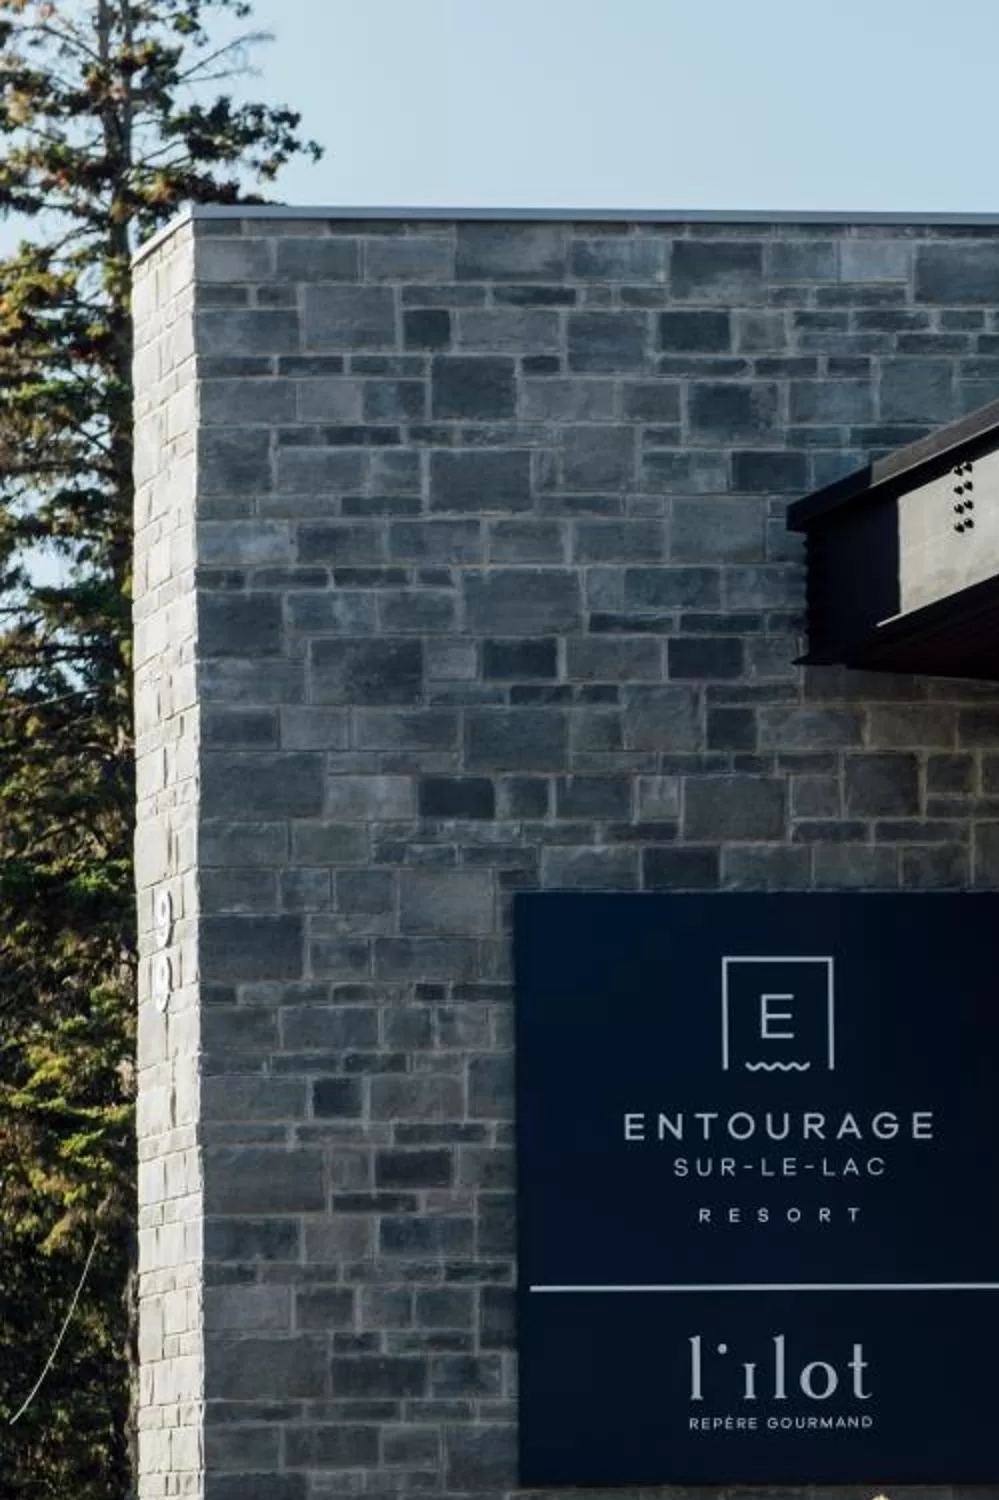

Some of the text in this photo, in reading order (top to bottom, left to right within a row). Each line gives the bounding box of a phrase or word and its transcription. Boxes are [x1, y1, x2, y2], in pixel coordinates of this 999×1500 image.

[761, 993, 795, 1039] E
[623, 1111, 934, 1141] ENTOURAGE
[673, 1156, 886, 1177] SUR-LE-LAC
[699, 1207, 861, 1223] RESORT
[766, 1416, 873, 1429] GOURMAND
